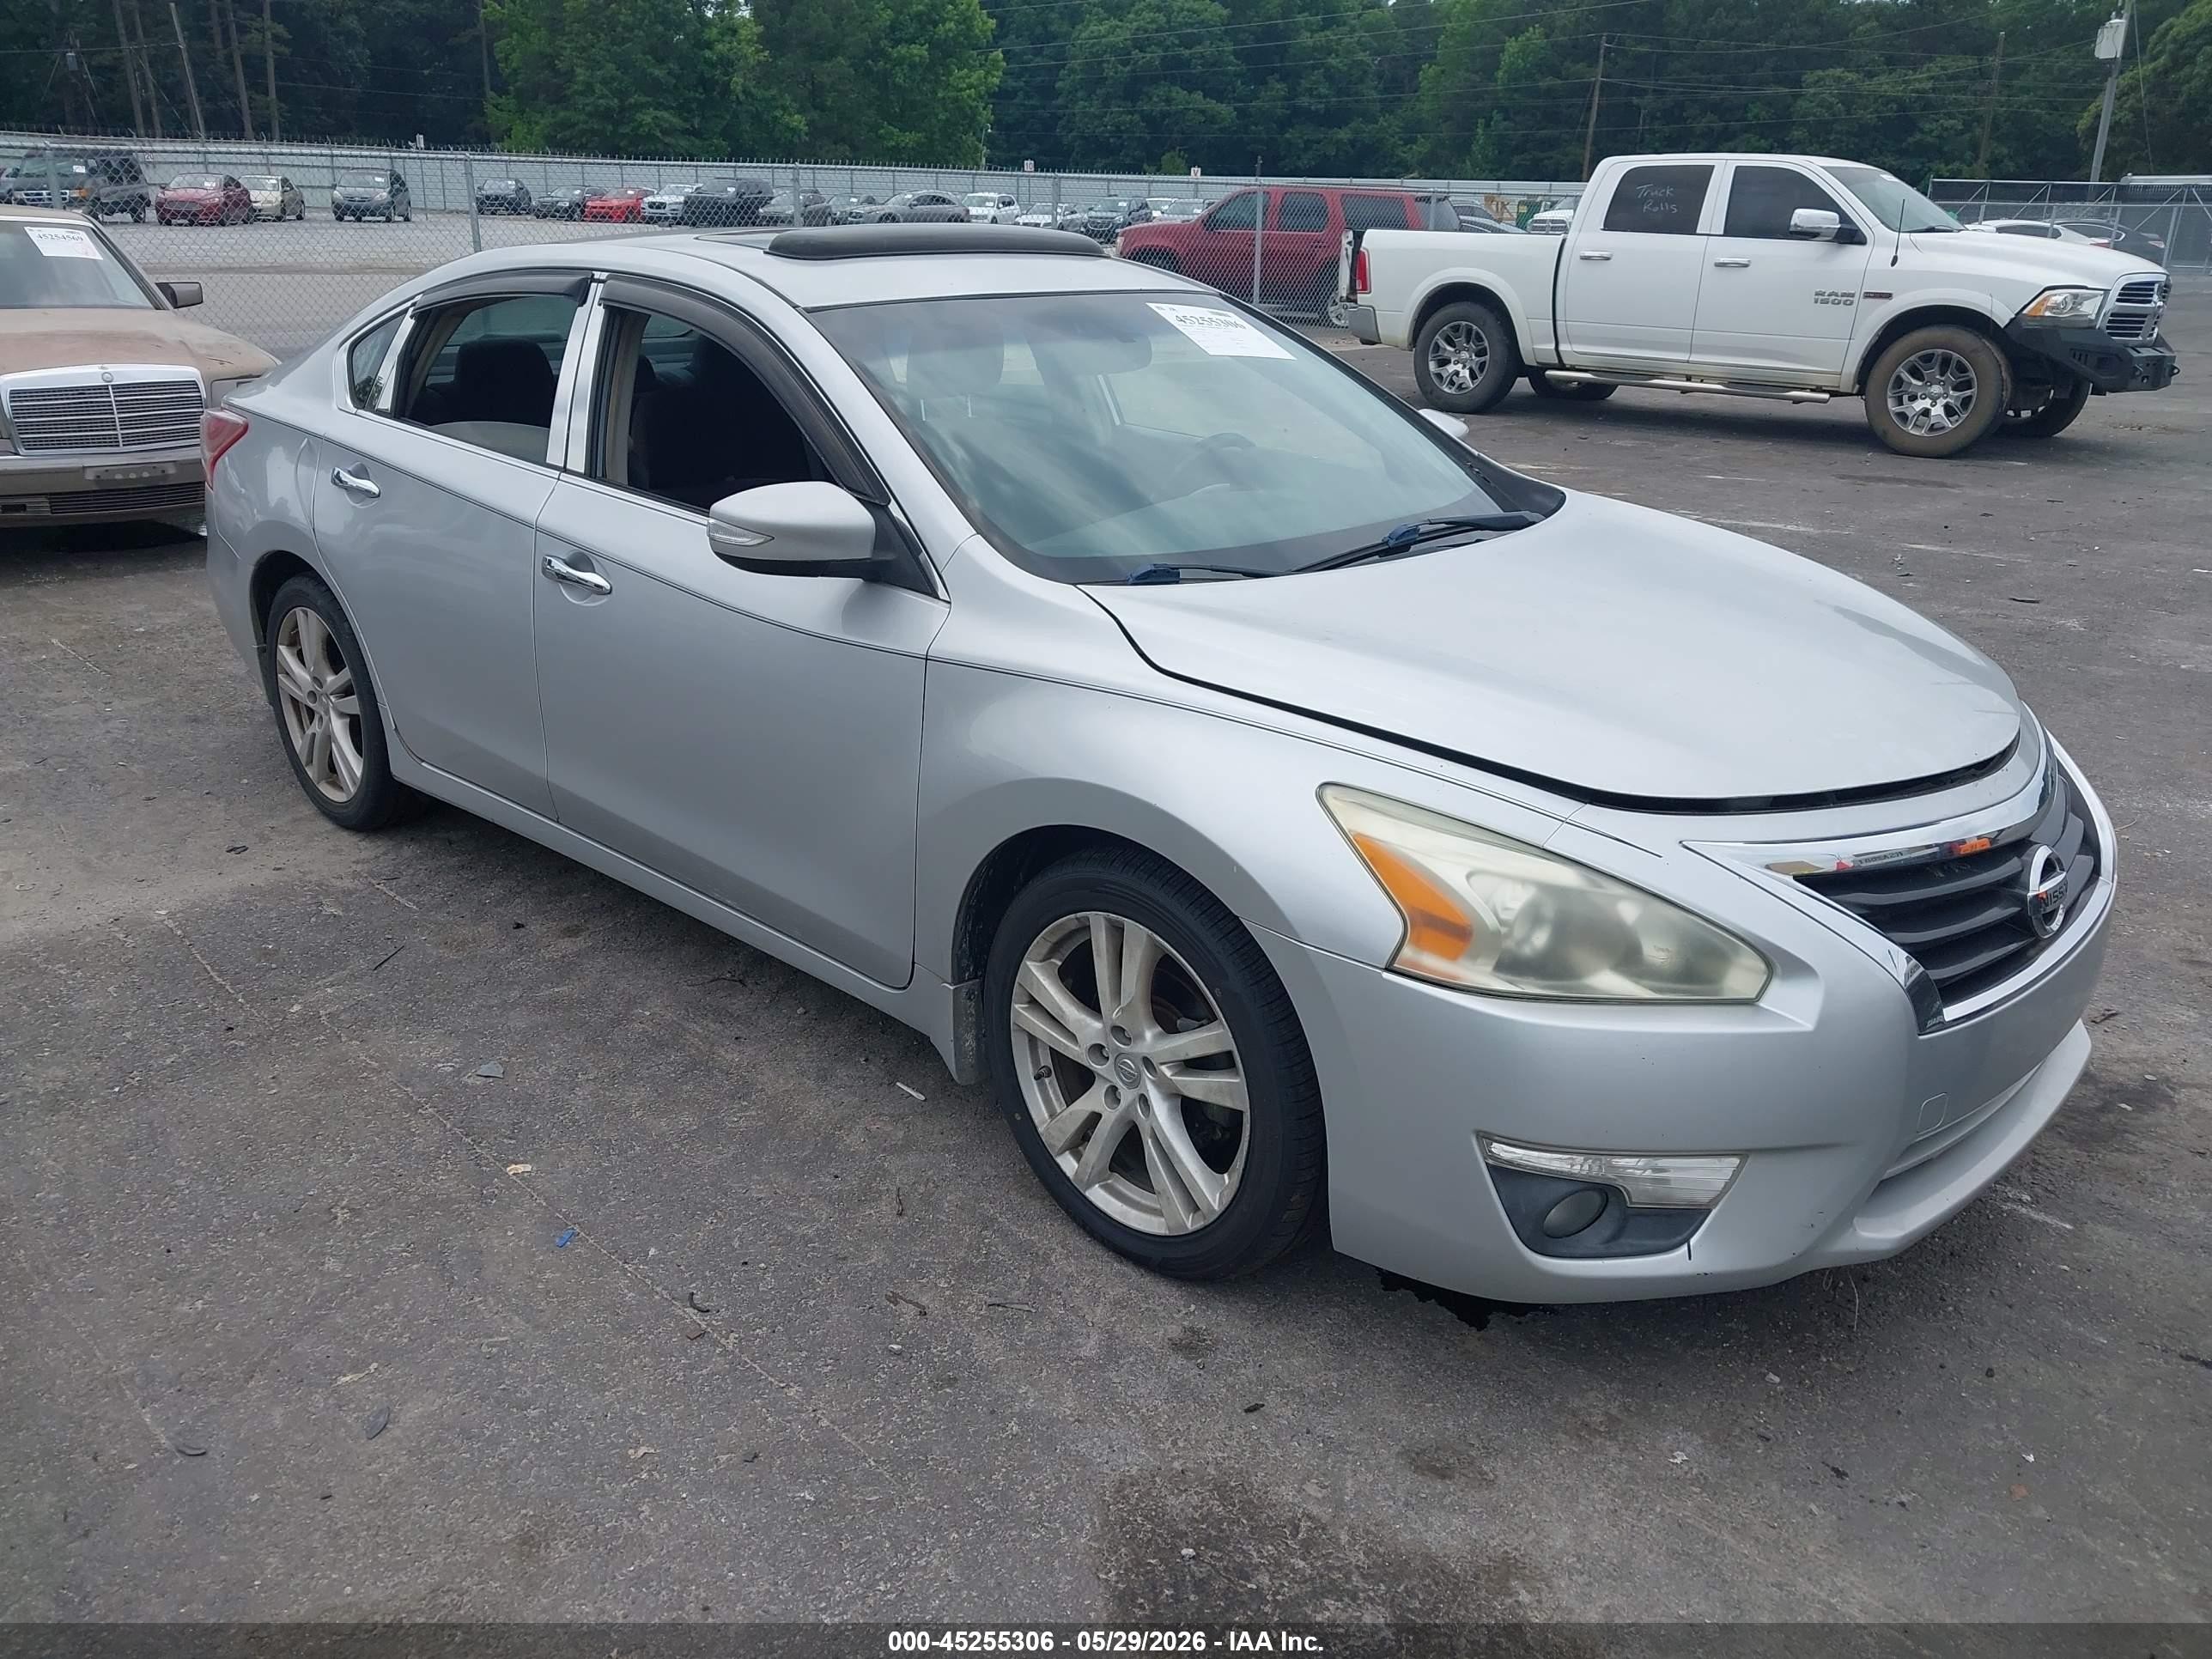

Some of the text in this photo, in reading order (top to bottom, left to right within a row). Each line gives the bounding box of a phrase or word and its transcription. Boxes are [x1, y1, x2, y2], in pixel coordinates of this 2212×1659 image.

[1636, 184, 1674, 198] Truck
[1643, 198, 1677, 214] Rolls
[1814, 297, 1854, 306] 1500
